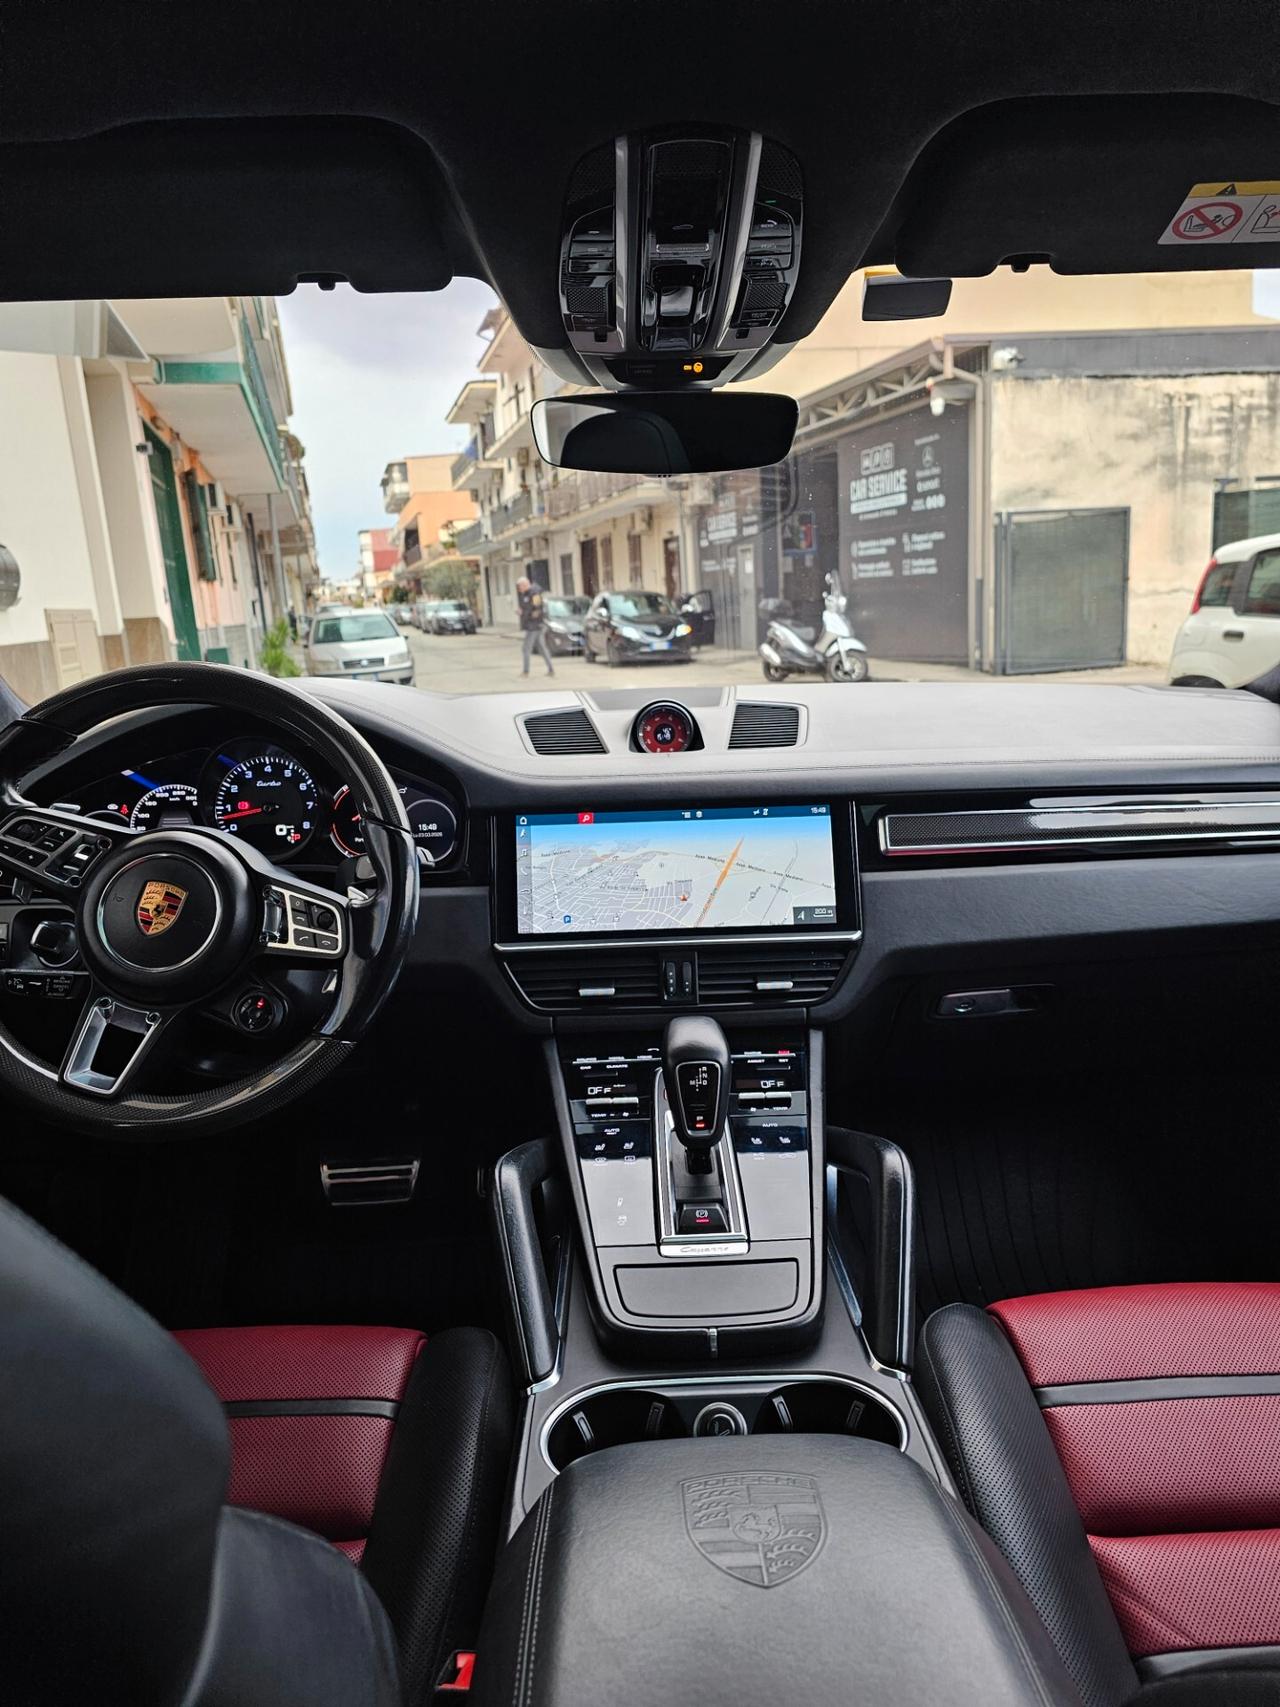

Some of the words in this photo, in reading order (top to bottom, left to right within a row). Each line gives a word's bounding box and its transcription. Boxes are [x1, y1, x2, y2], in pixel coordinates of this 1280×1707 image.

[850, 478, 867, 502] CAR
[868, 468, 908, 498] SERVICE
[276, 824, 287, 835] 0
[760, 1080, 784, 1088] OFF
[588, 1087, 612, 1095] OFF
[686, 1476, 815, 1488] PORSCHE
